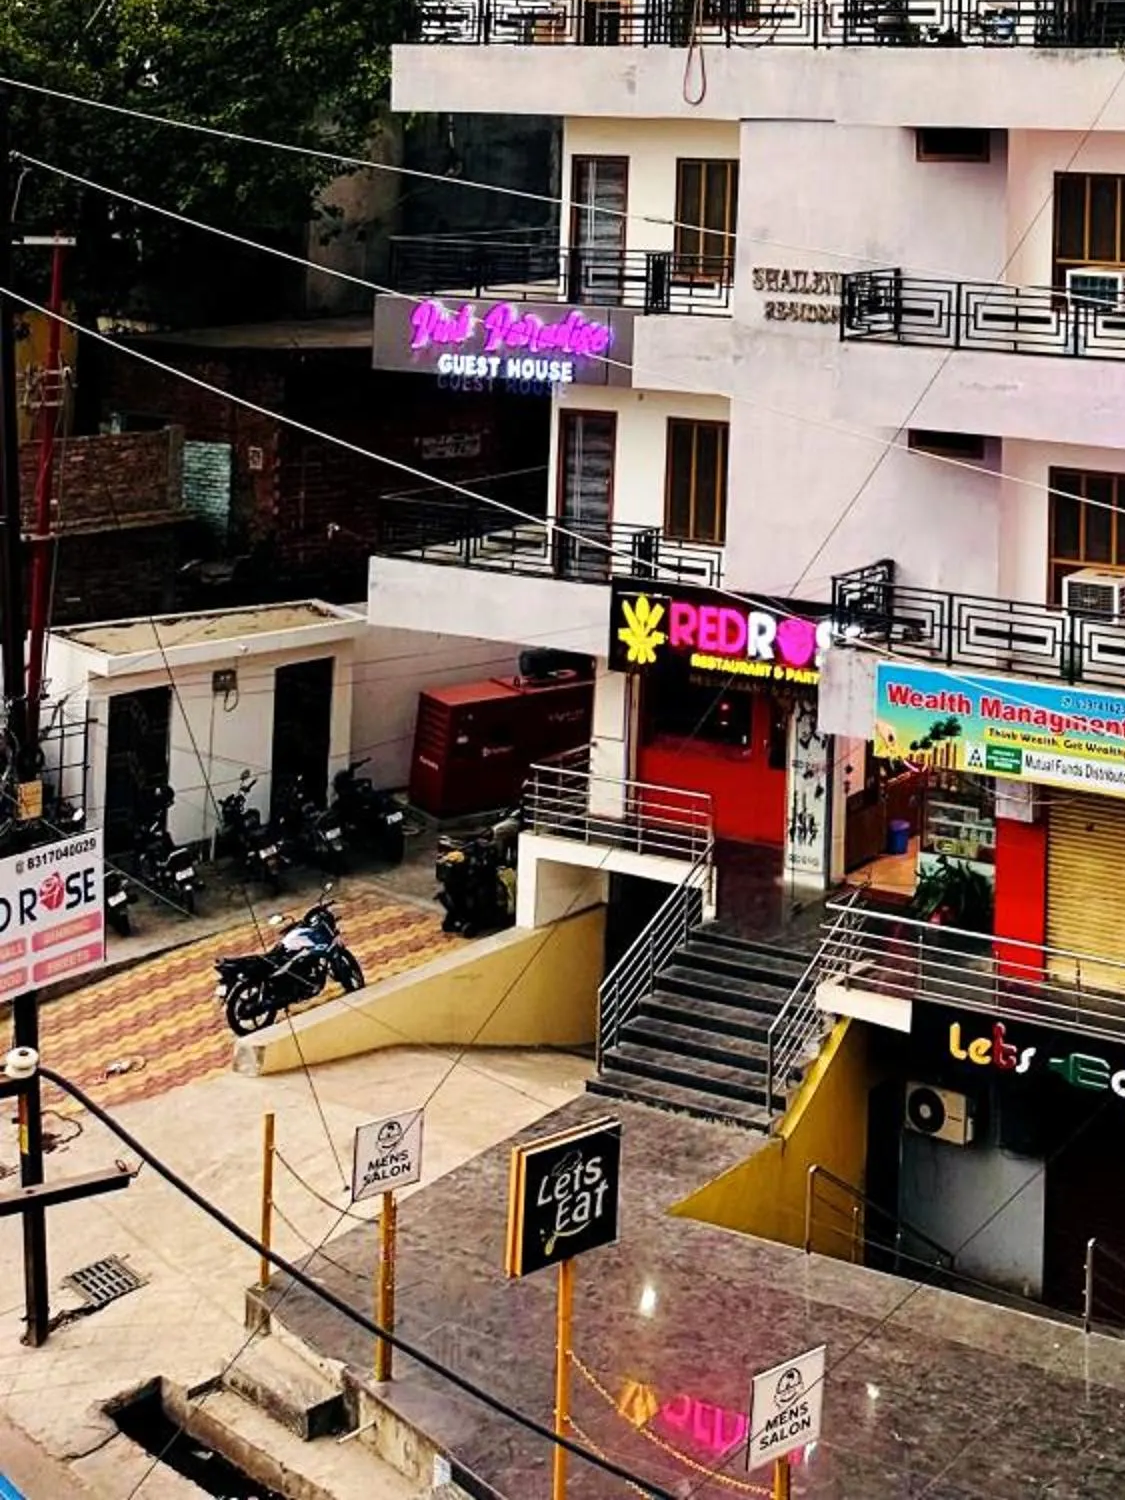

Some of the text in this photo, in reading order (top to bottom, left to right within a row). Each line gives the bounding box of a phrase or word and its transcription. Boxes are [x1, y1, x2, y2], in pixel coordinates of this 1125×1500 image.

[410, 299, 614, 355] Pink Paradise
[438, 354, 573, 382] GUEST HOUSE
[691, 654, 773, 678] RESTAURANT
[785, 668, 820, 685] PART
[886, 682, 972, 717] Wealth
[989, 727, 1018, 742] Think
[1063, 739, 1084, 752] Get
[1025, 754, 1055, 774] Mutual
[1055, 759, 1084, 779] Funds
[362, 1162, 411, 1187] SALON
[367, 1150, 409, 1172] MENS
[537, 1156, 602, 1207] Lets
[555, 1179, 608, 1231] Eat
[764, 1401, 810, 1432] MENS
[759, 1416, 812, 1450] SALON
